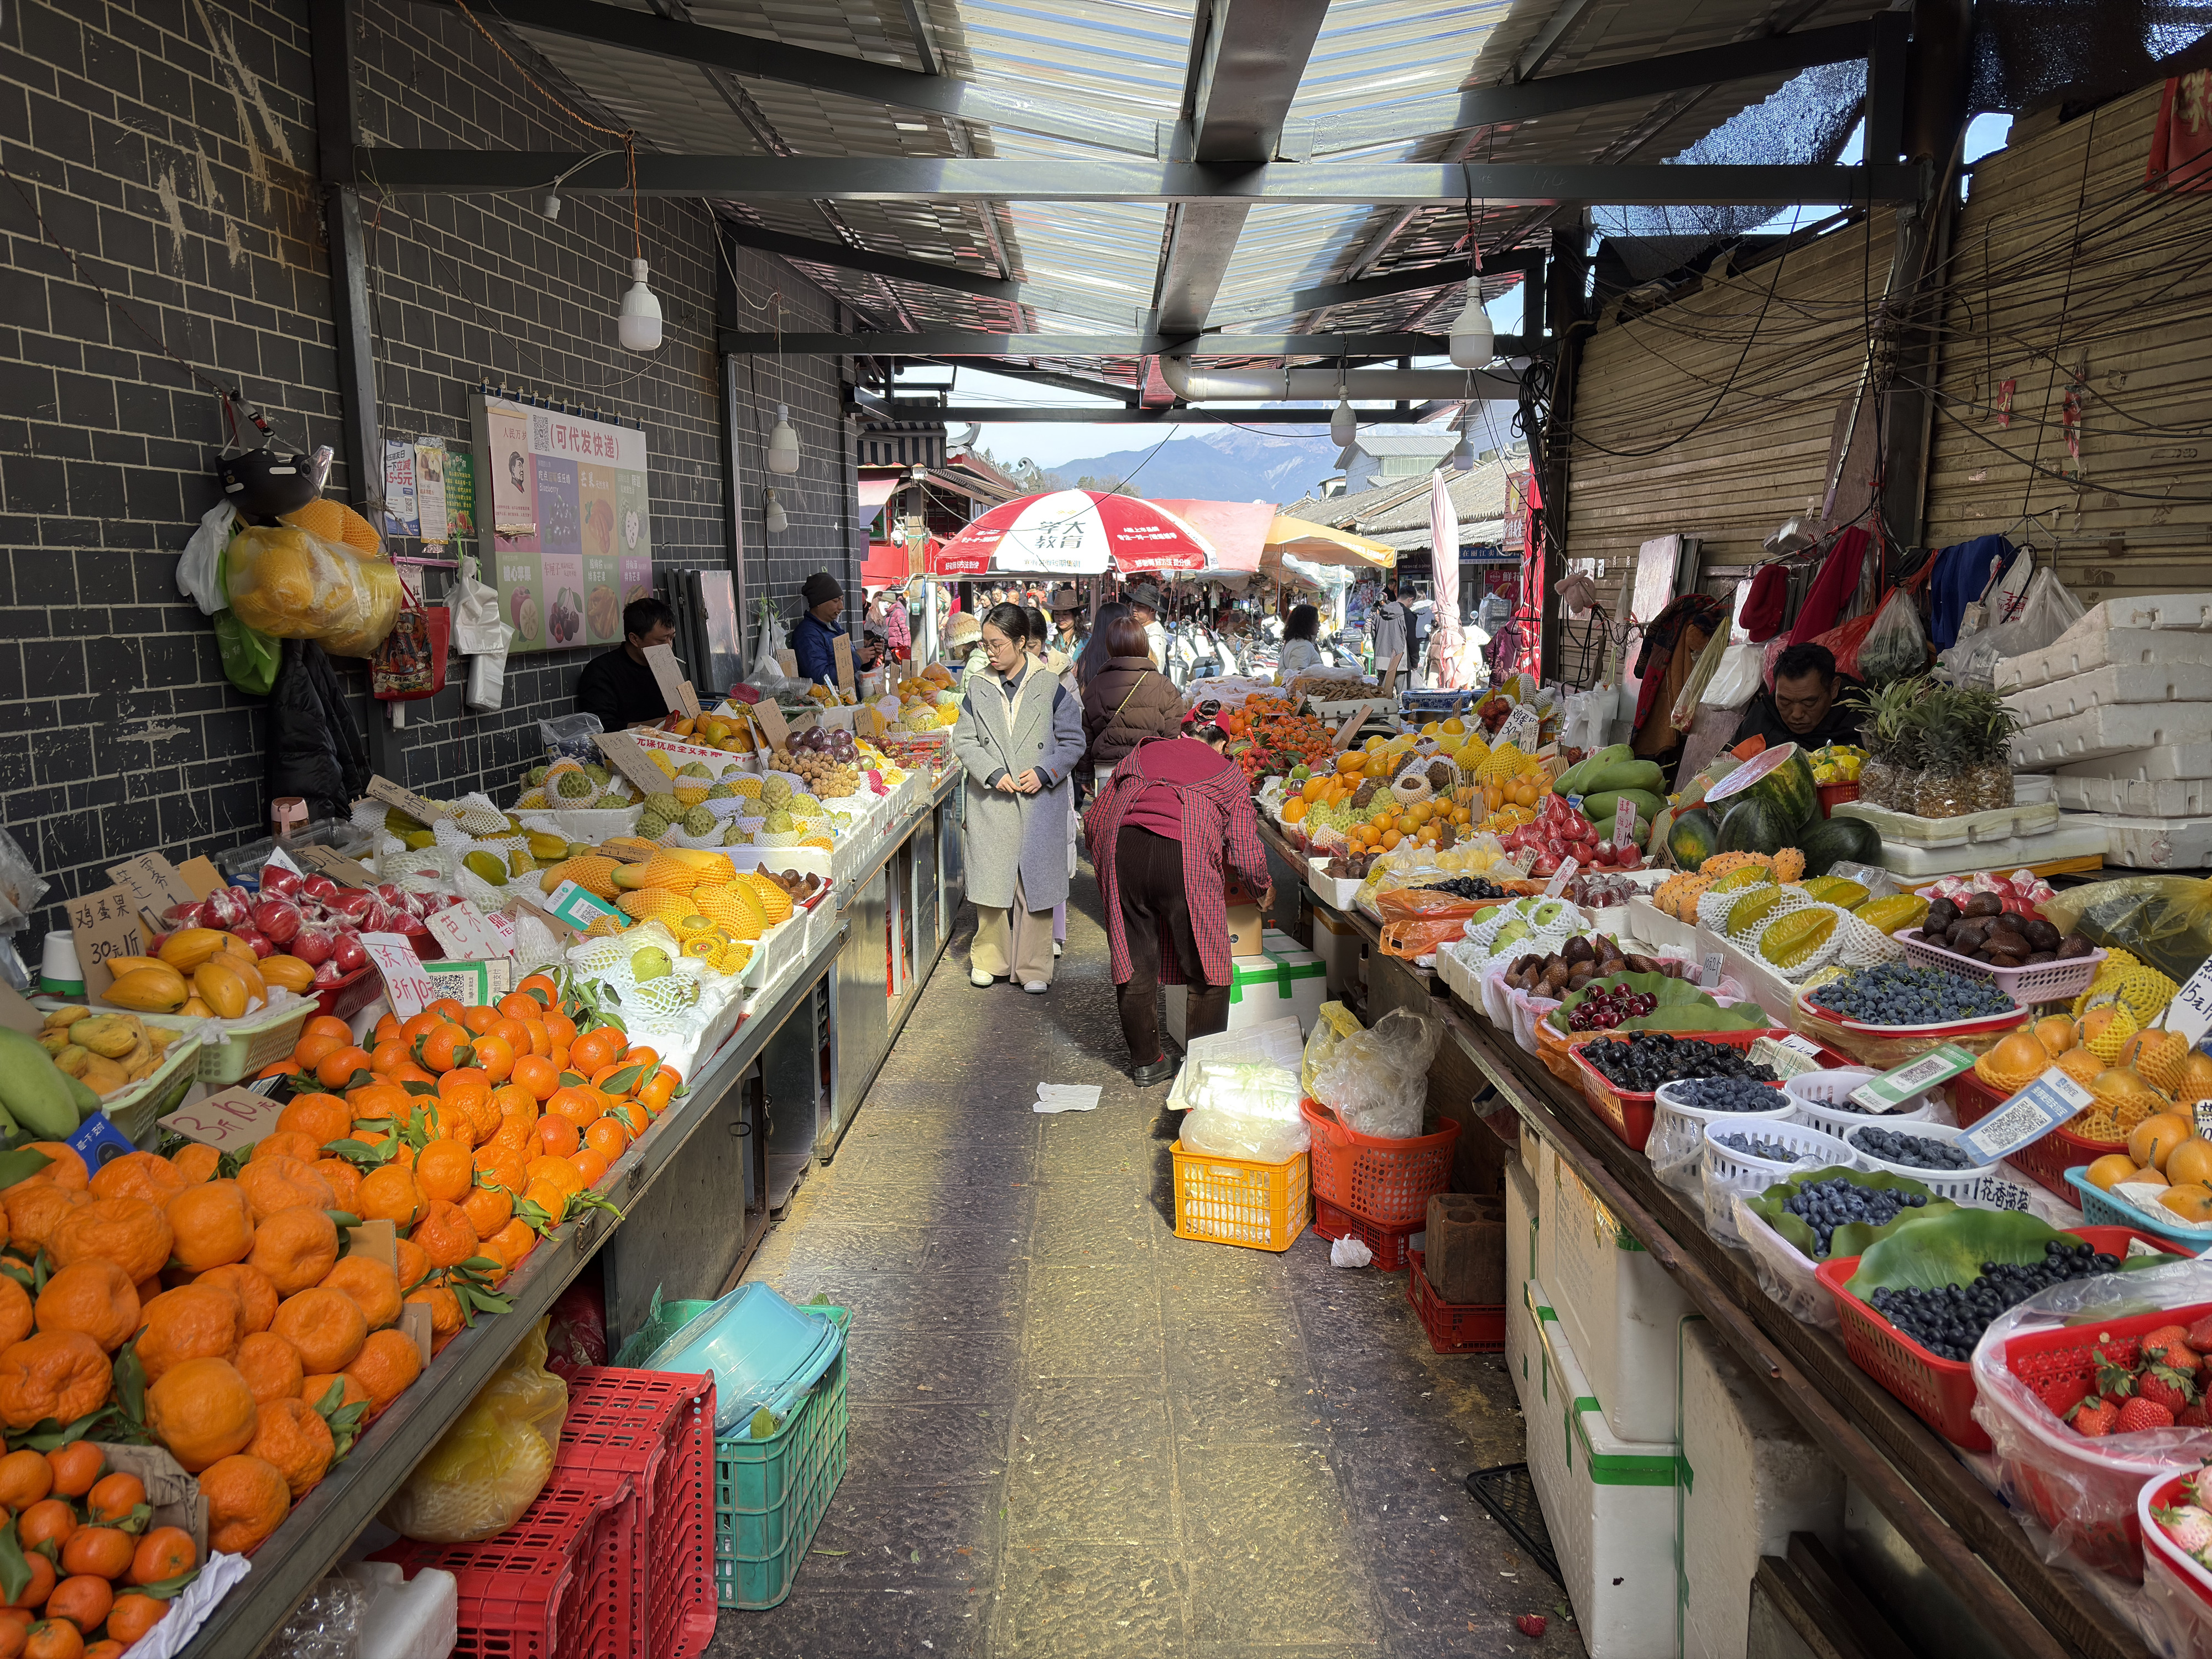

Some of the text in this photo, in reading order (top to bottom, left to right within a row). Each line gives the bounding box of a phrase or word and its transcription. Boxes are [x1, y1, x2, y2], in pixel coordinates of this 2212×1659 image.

[550, 424, 619, 460] (可代发快递)
[387, 450, 405, 461] 五碰友日
[539, 482, 559, 495] Blueberry
[1040, 521, 1086, 534] 学大
[1035, 535, 1083, 549] 教育
[75, 894, 129, 928] 鸡蛋果
[493, 969, 501, 994] 微信支付
